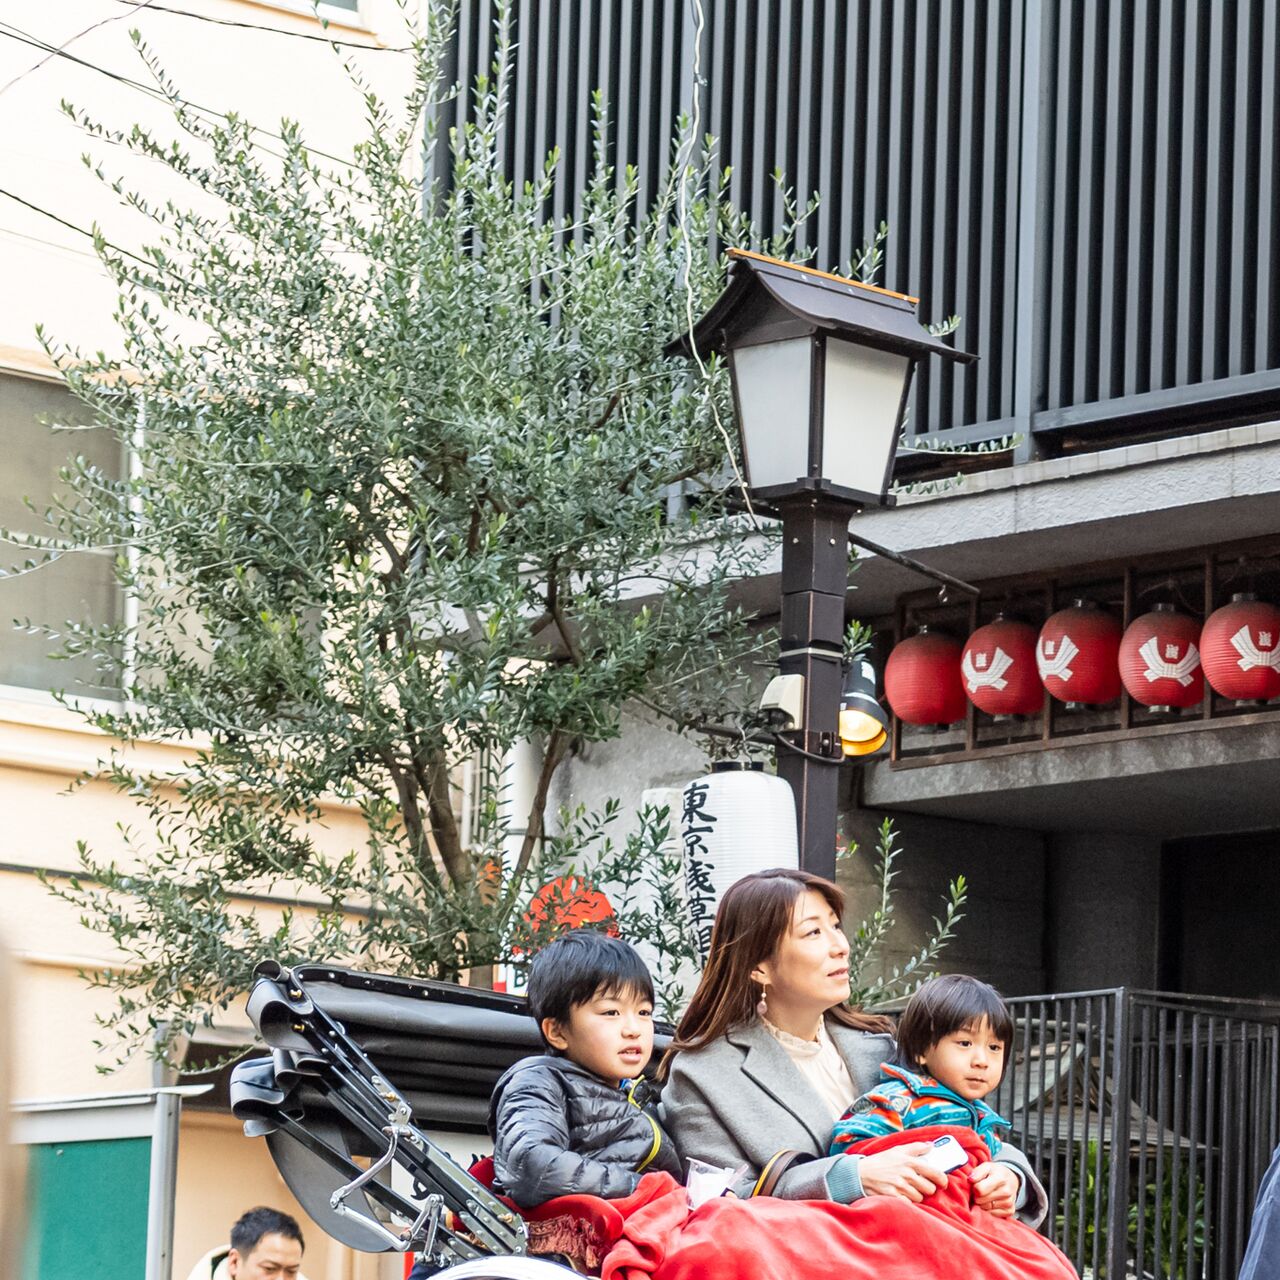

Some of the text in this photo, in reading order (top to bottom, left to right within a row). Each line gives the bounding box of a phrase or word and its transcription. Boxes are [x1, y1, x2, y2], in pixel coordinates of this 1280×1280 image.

[681, 782, 717, 970] 東京浅草組
